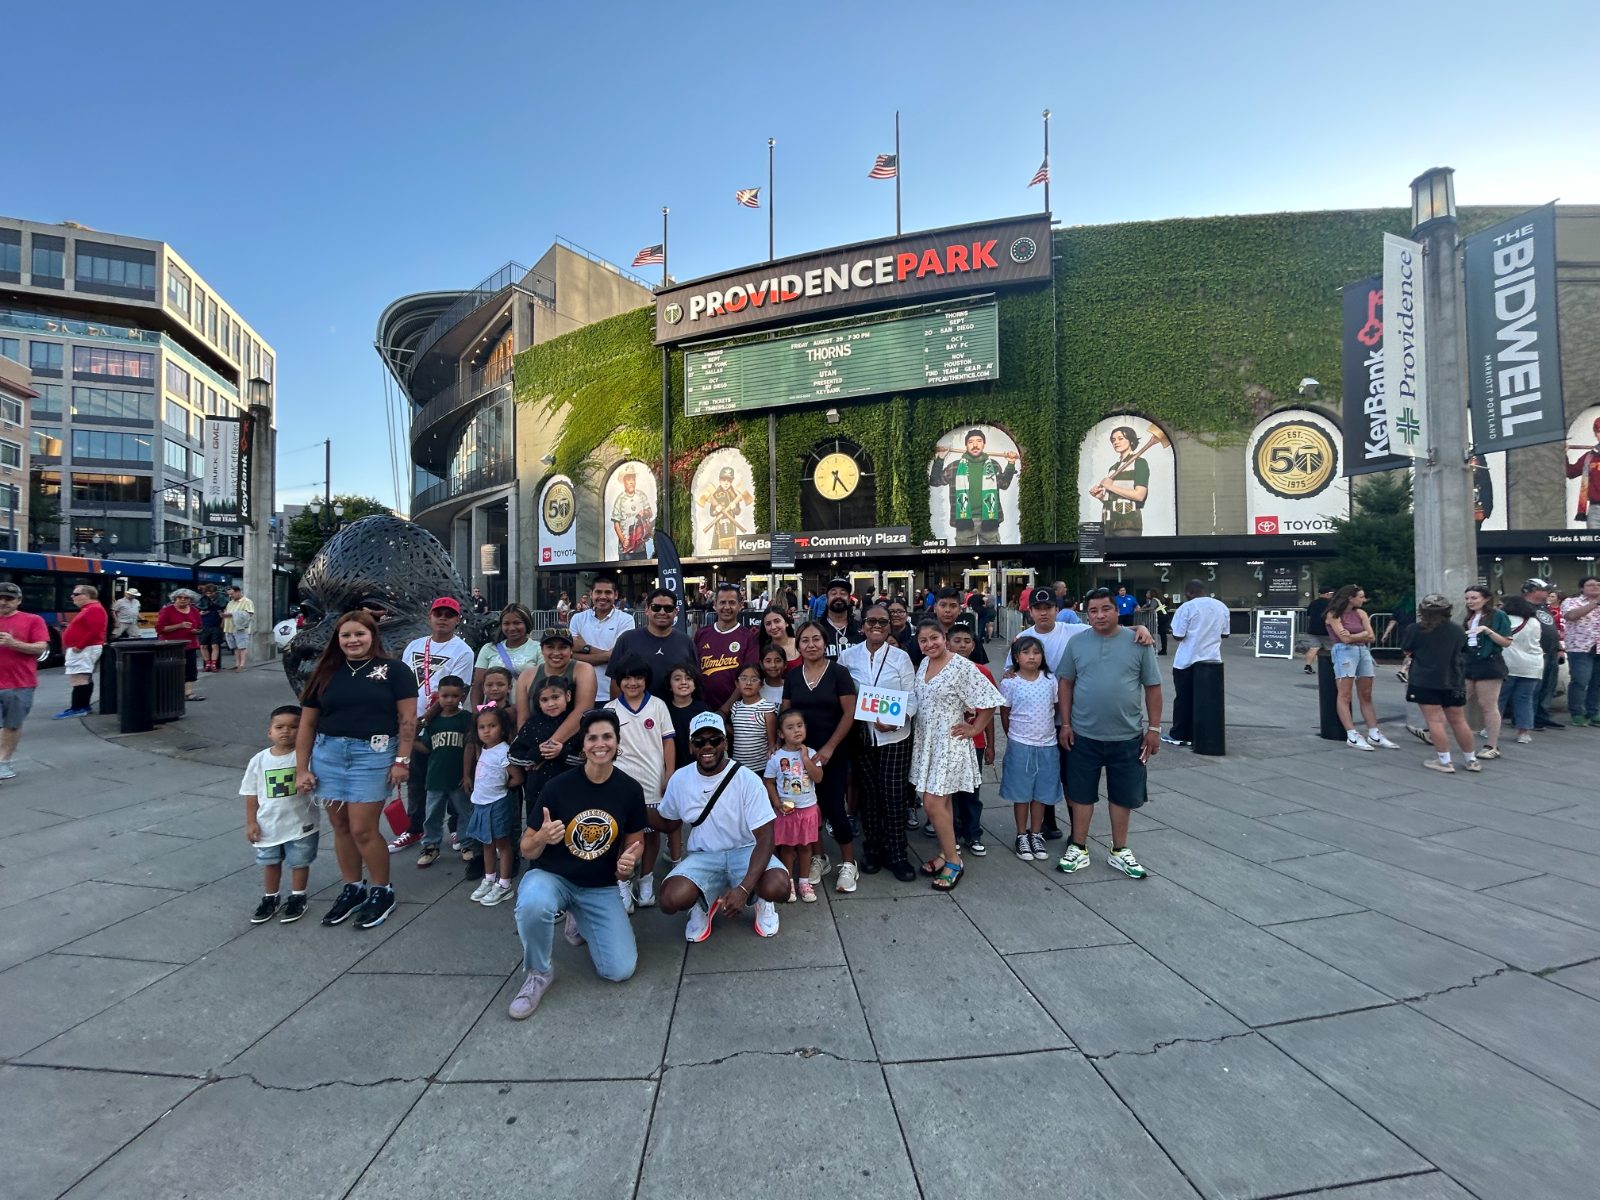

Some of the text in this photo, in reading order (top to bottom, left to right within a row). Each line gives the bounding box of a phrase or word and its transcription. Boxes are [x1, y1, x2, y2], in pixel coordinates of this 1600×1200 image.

[1493, 224, 1534, 246] THE
[944, 310, 969, 319] THORNS
[956, 323, 975, 331] DIEGO
[1397, 250, 1416, 400] Providence
[791, 342, 809, 350] FRIDAY
[813, 338, 833, 346] AUGUST
[1494, 237, 1543, 438] BIDWELL
[806, 344, 852, 361] THORNS
[944, 359, 972, 368] HOUSTON
[819, 369, 837, 378] UTAH
[813, 377, 843, 386] PRESENTED
[1484, 354, 1497, 440] MARRIOTT PORTLAND
[212, 422, 220, 449] GMC
[241, 454, 249, 518] KeyBank
[1287, 480, 1306, 488] 1975
[1284, 520, 1335, 531] TOYOT
[810, 534, 872, 547] Community
[875, 533, 907, 544] Plaza
[1160, 567, 1170, 582] 2
[1207, 566, 1216, 581] 3
[1253, 565, 1264, 581] 4
[1301, 565, 1310, 580] 5
[1493, 564, 1503, 578] 9
[1538, 562, 1552, 578] 10
[664, 577, 677, 592] D
[701, 654, 740, 671] Timbers
[863, 692, 901, 702] PROJECT
[861, 698, 901, 716] LEDO
[431, 731, 464, 750] BOSTON
